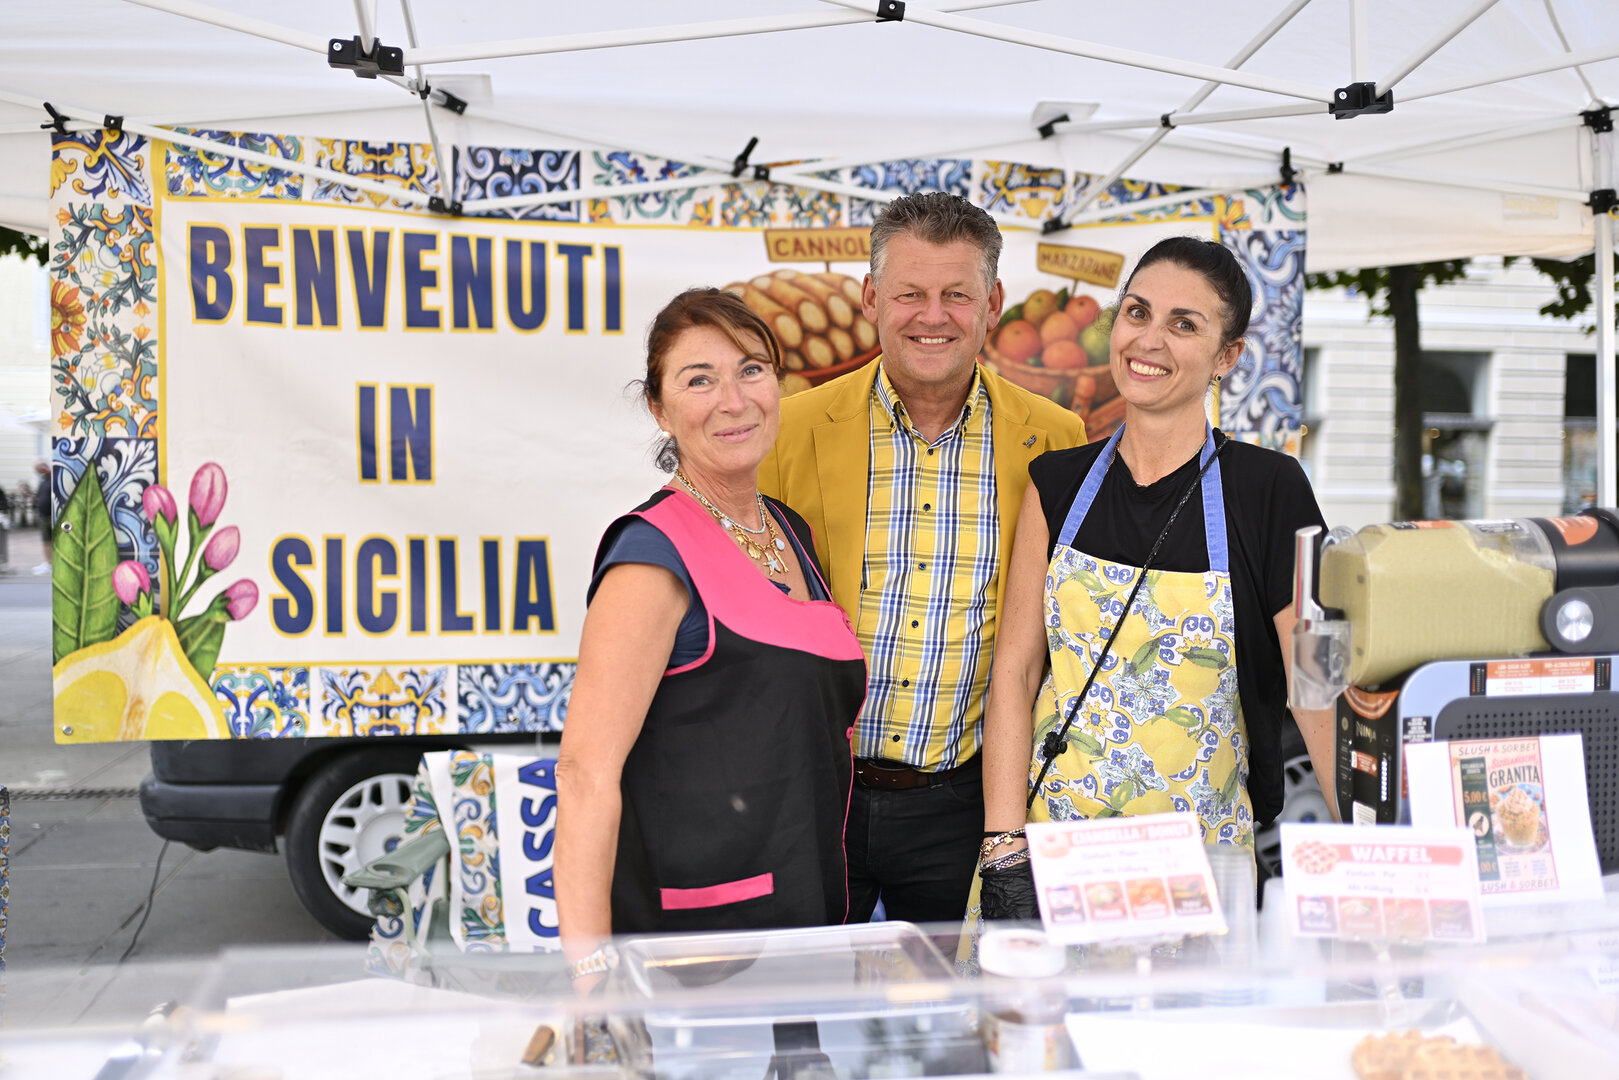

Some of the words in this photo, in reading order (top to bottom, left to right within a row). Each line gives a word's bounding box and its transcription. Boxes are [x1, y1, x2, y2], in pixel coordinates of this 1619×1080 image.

[774, 236, 870, 257] CANNOL
[187, 222, 624, 334] BENVENUTI
[356, 381, 436, 485] IN
[269, 533, 558, 637] SICILIA
[1355, 720, 1377, 743] NINJA
[1458, 745, 1491, 756] SLUSH
[1492, 745, 1499, 753] &
[1502, 743, 1537, 754] SORBET
[1489, 765, 1541, 788] GRANITA
[1464, 791, 1482, 804] 5.00
[518, 757, 559, 937] CASSA
[1351, 846, 1431, 862] WAFFEL
[1481, 881, 1507, 892] LUSH
[1519, 879, 1555, 889] SORBET
